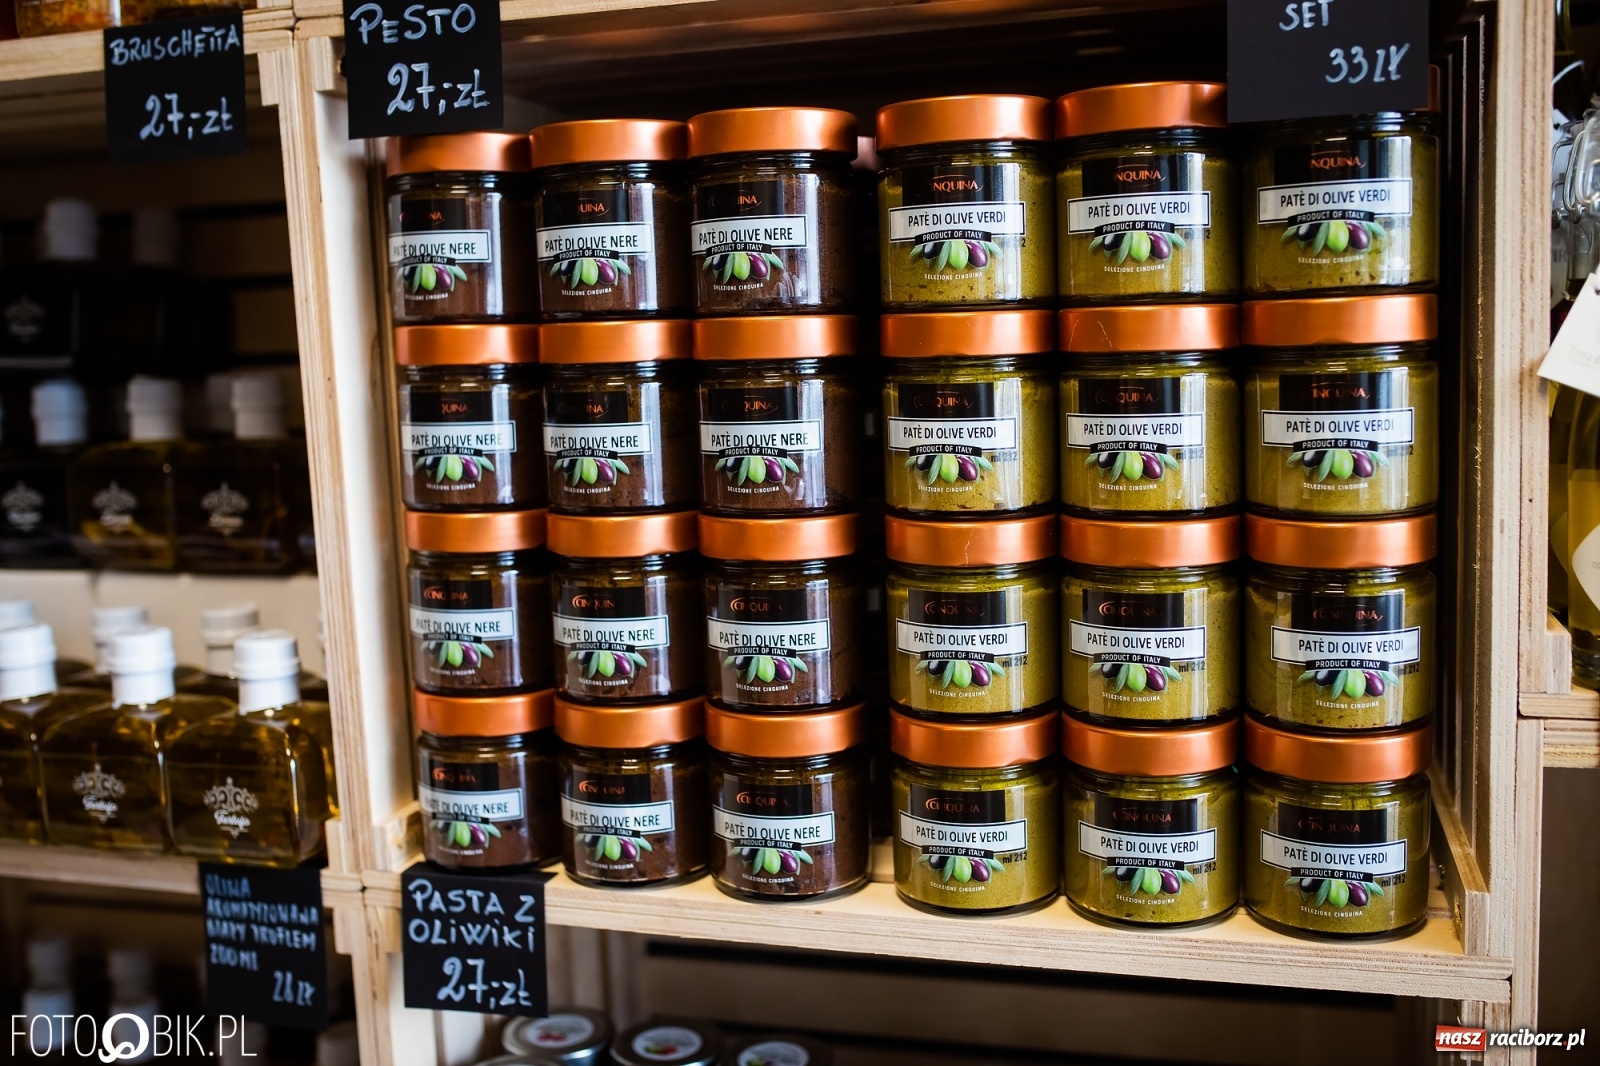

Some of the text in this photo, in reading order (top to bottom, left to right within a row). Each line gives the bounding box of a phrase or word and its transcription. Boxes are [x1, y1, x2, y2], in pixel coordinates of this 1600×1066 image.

[350, 2, 477, 45] PESTO
[1279, 0, 1334, 31] SET
[109, 24, 240, 66] BRUSCHETTA
[1281, 190, 1305, 207] PATÈ
[1308, 192, 1320, 205] DI
[1323, 191, 1355, 204] OLIVE
[1088, 201, 1190, 218] PATÈ DI OLIVE VERDI
[909, 211, 1005, 227] PATÈ DI OLIVE VERDI
[545, 235, 637, 251] PATÈ DI OLIVE NERE
[699, 228, 792, 245] PATÈ DI OLIVE NERE
[923, 231, 952, 241] PRODUCT
[965, 231, 983, 239] ITALY
[409, 244, 418, 256] DI
[420, 243, 445, 257] OLIVE
[449, 243, 476, 254] NERE
[712, 243, 735, 251] PRODUCT
[903, 425, 996, 439] PATÈ DI OLIVE VERDI
[1084, 422, 1181, 435] PATÈ DI OLIVE VERDI
[1287, 418, 1311, 432] PATÈ
[1315, 421, 1324, 432] DI
[1327, 420, 1360, 432] OLIVE
[432, 434, 440, 447] DI
[444, 434, 472, 447] OLIVE
[475, 433, 502, 445] NERE
[551, 432, 638, 449] PATÈ DI OLIVE NERE
[712, 432, 730, 447] PATÈ
[734, 434, 743, 447] DI
[746, 434, 776, 446] OLIVE
[433, 621, 441, 634] DI
[444, 621, 471, 634] OLIVE
[475, 621, 500, 632] NERE
[563, 627, 654, 642] PATÈ DI OLIVE NERE
[720, 631, 815, 646] PATÈ DI OLIVE NERE
[914, 631, 1007, 645] PATÈ DI OLIVE VERDI
[1088, 632, 1184, 649] PATÈ DI OLIVE VERDI
[1299, 638, 1403, 653] PATÈ DI OLIVE VERDI
[772, 648, 788, 656] ITALY
[442, 801, 450, 811] DI
[453, 802, 479, 814] OLIVE
[483, 802, 509, 814] NERE
[570, 810, 660, 827] PATÈ DI OLIVE NERE
[725, 821, 820, 840] PATÈ DI OLIVE NERE
[917, 826, 1007, 843] PATÈ DI OLIVE VERDI
[1101, 836, 1198, 853] PATÈ DI OLIVE VERDI
[1284, 846, 1387, 865] PATÈ DI OLIVE VERDI
[407, 878, 536, 923] PASTA Z
